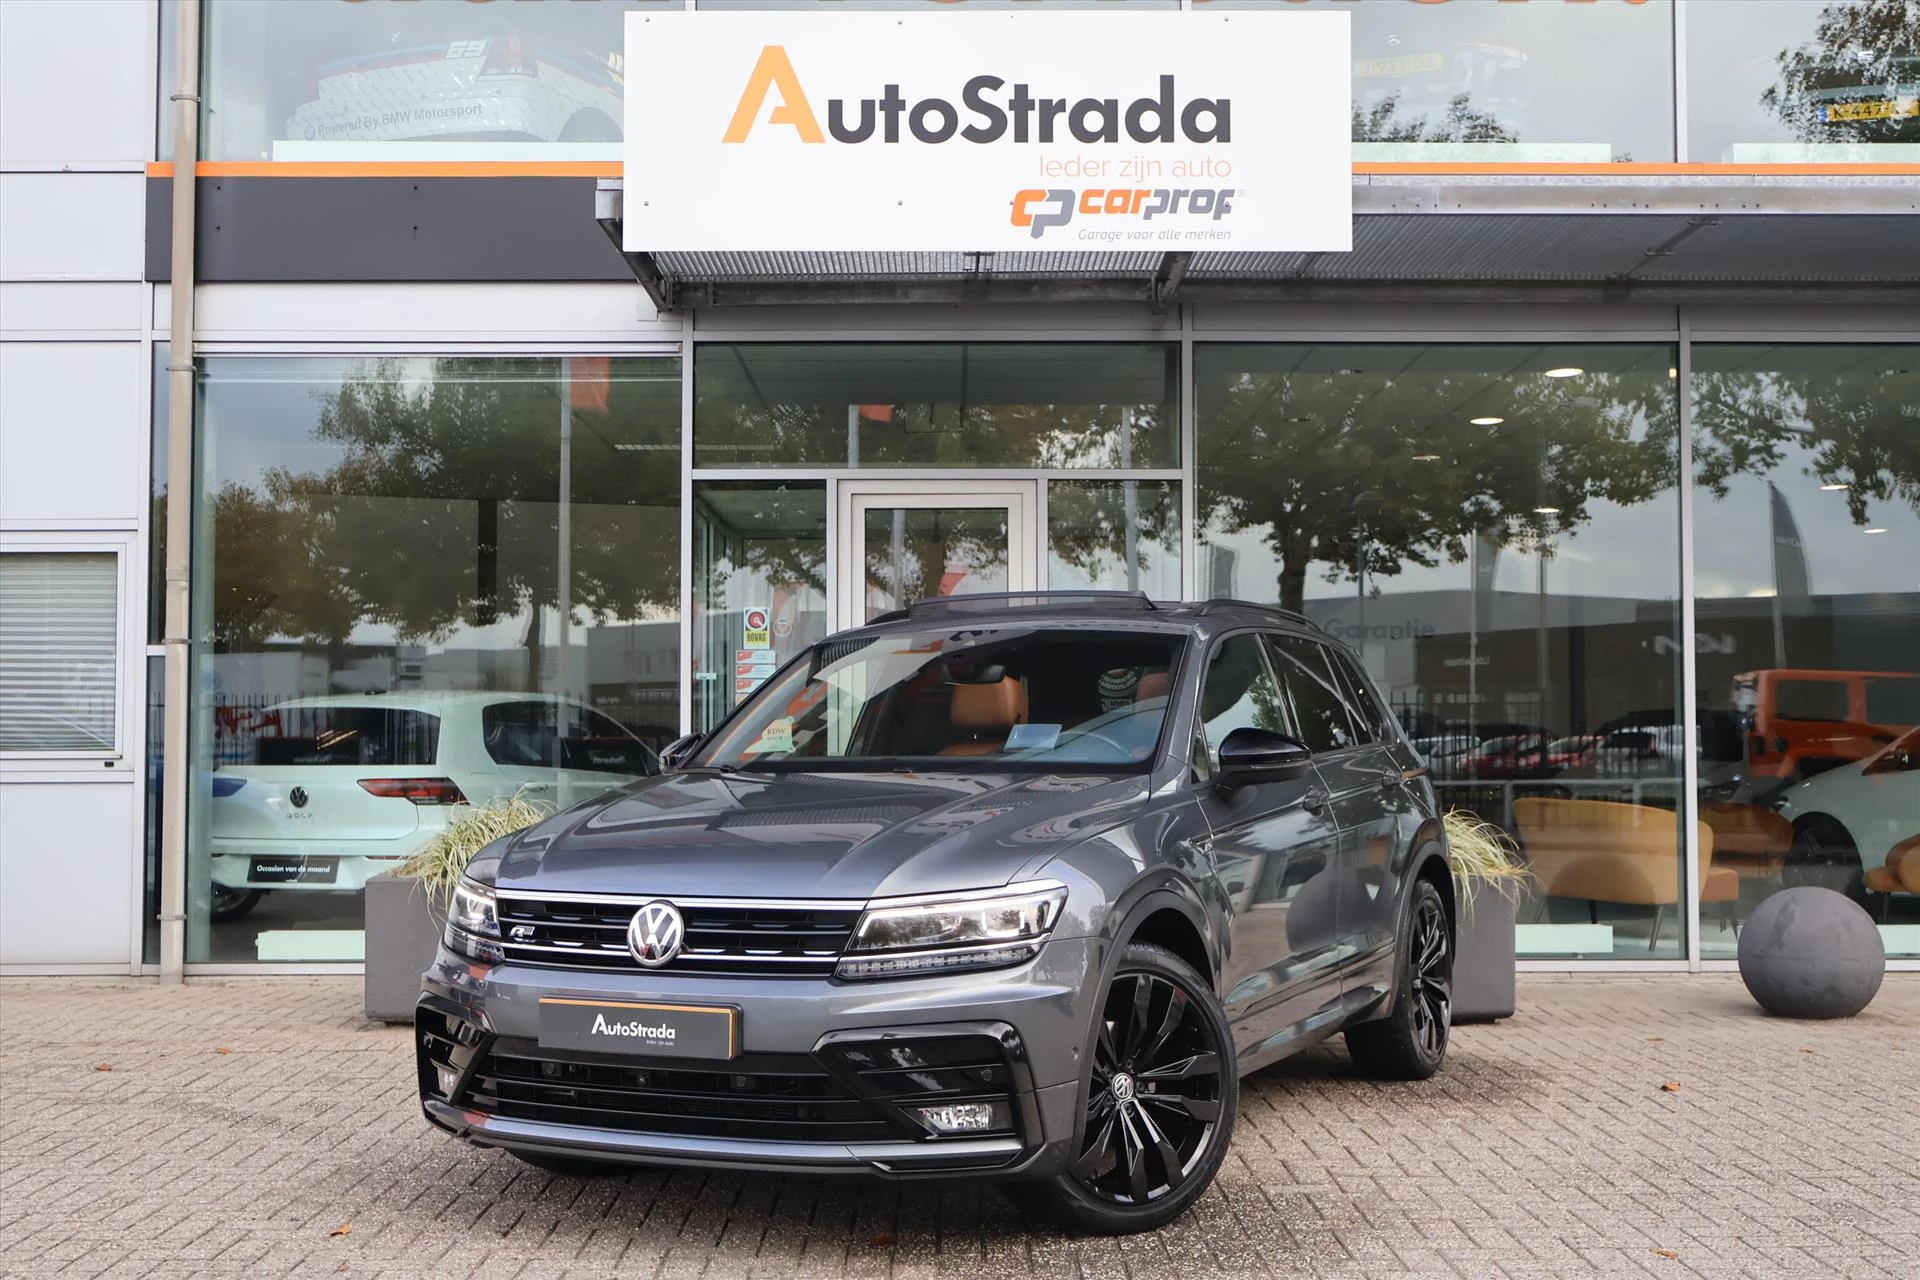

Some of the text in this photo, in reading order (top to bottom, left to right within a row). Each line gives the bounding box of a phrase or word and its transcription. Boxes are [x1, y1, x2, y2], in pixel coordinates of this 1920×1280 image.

[444, 40, 488, 59] 69
[721, 44, 1232, 145] AutoStrada
[318, 103, 484, 137] Powered By BMW Motorsport
[1039, 155, 1232, 183] Ieder zijn auto
[1078, 229, 1231, 242] Garage voor alle merken
[1323, 618, 1436, 640] Garantie
[256, 864, 331, 873] Occasion van de maand
[591, 1013, 676, 1039] AutoStrada
